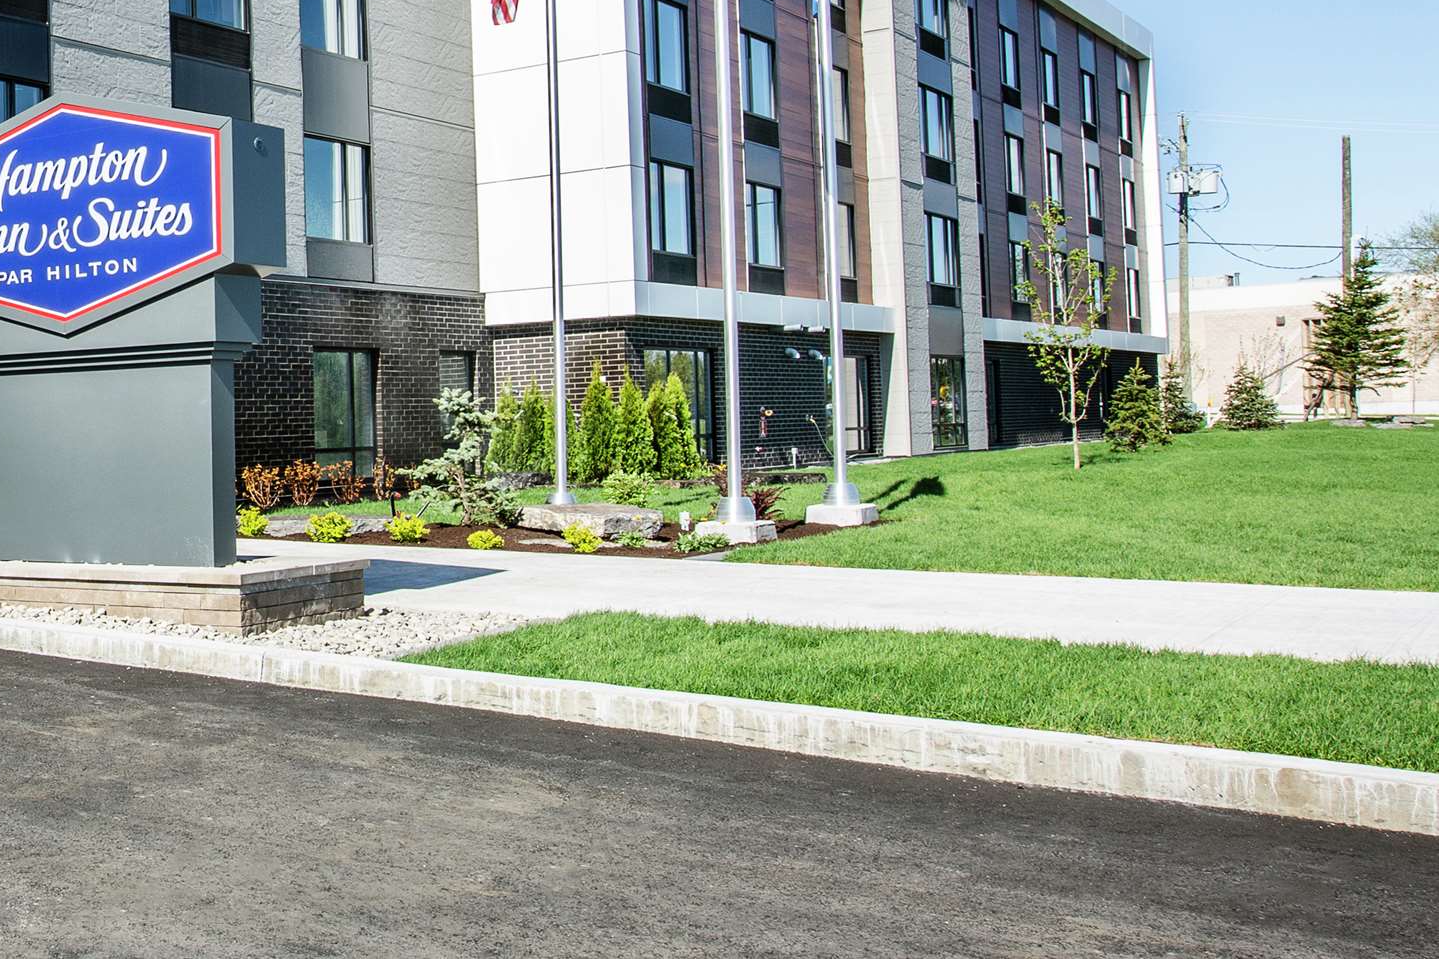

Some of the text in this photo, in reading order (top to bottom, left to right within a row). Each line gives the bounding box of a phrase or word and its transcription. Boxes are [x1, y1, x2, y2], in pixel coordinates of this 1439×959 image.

[48, 218, 77, 253] &
[72, 197, 193, 247] Suites
[47, 257, 138, 281] HILTON
